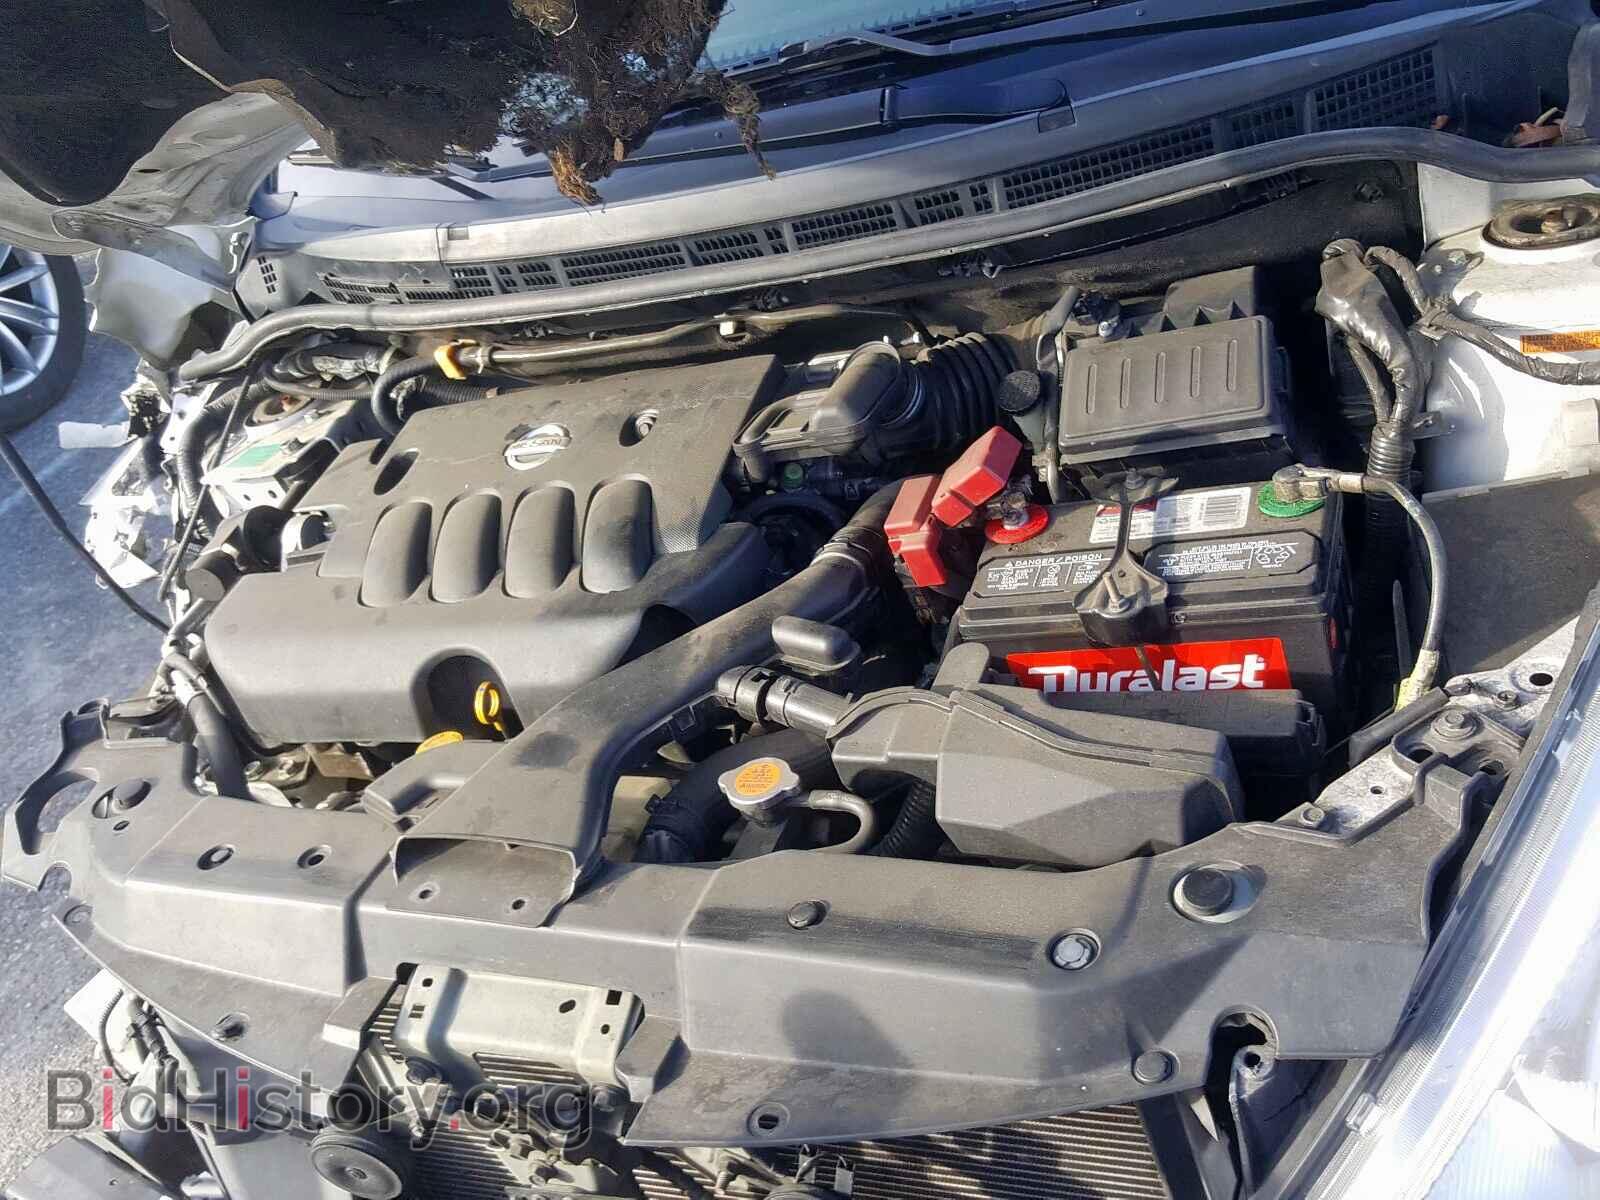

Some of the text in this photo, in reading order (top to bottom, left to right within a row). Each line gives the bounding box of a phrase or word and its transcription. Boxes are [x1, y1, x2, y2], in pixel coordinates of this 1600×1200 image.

[1015, 557, 1055, 566] DANGER
[1064, 553, 1103, 562] POISON
[1027, 652, 1266, 693] Duralast
